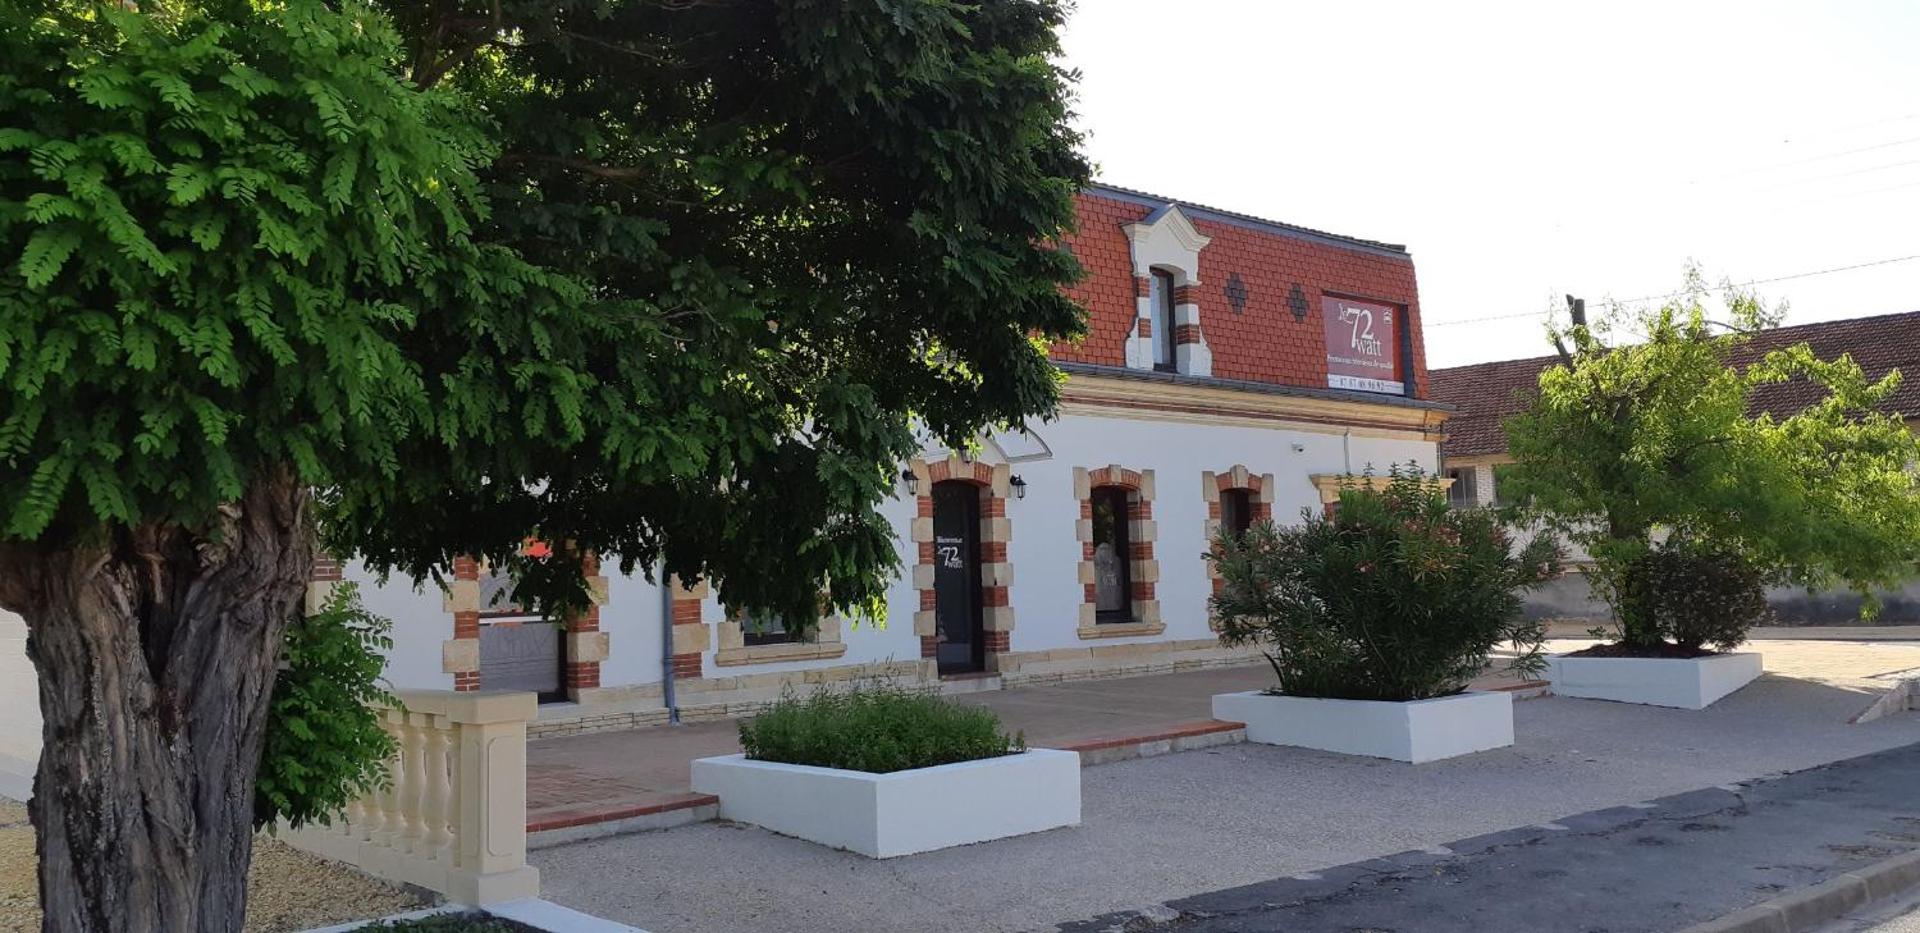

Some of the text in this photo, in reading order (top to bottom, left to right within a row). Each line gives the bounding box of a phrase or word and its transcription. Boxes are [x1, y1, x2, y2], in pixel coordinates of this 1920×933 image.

[1347, 308, 1374, 348] 72
[1357, 339, 1382, 356] watt
[942, 547, 959, 566] 72
